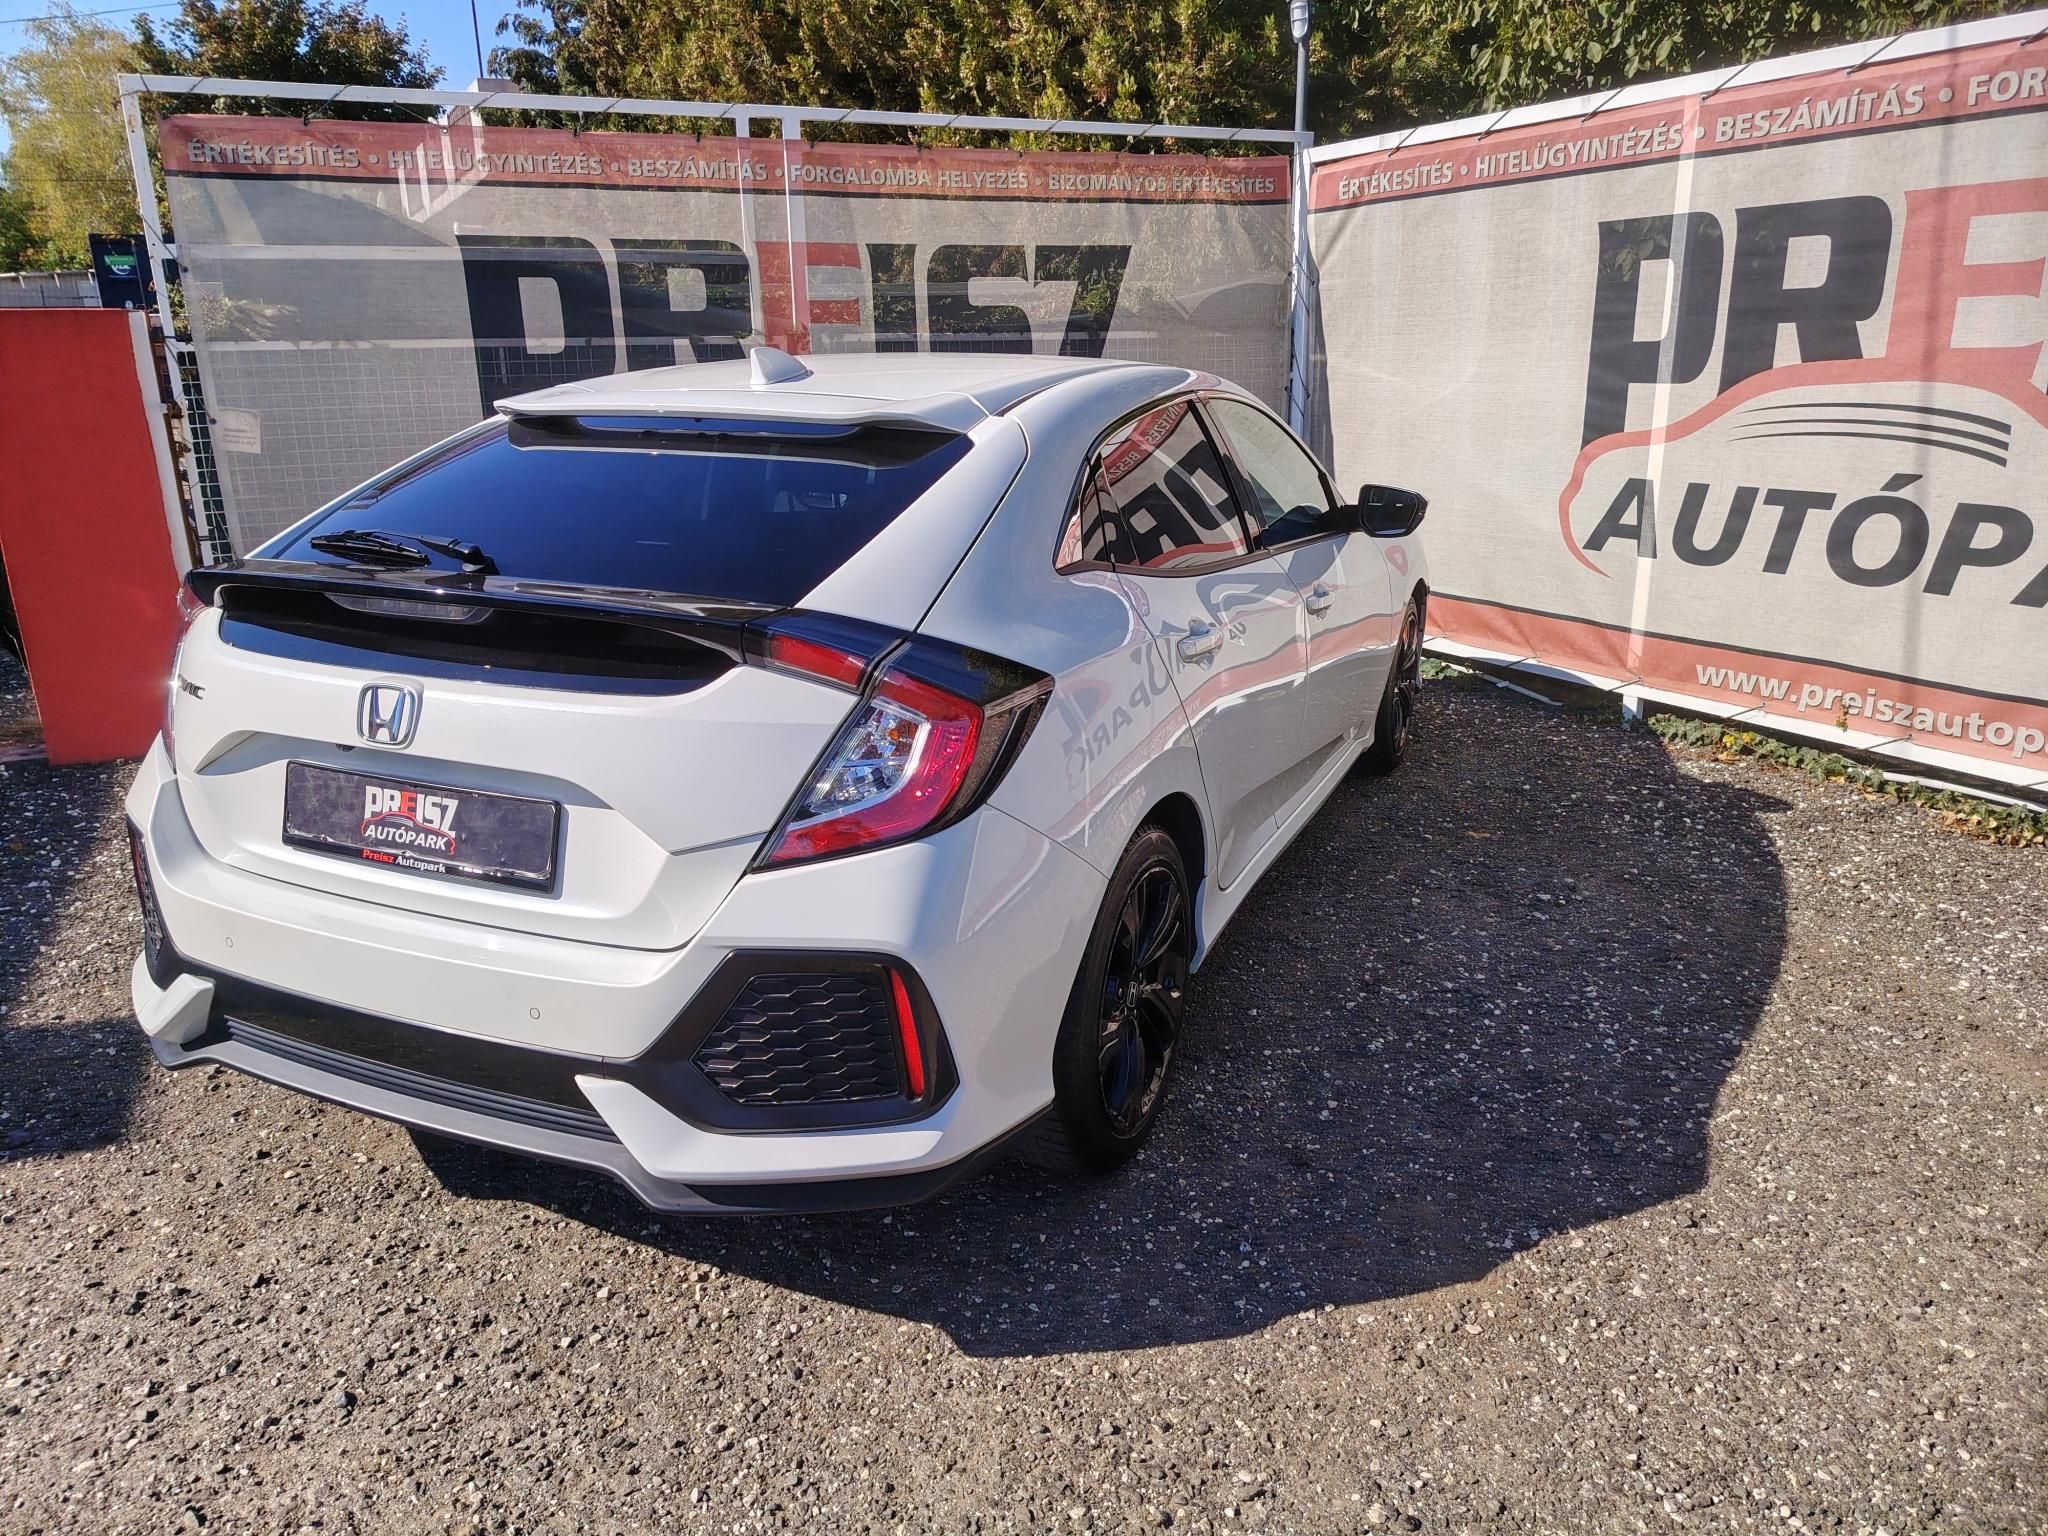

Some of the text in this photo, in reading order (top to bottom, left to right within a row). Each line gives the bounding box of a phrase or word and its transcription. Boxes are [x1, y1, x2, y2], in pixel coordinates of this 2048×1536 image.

[187, 138, 360, 168] ÉRTÉKESÍTÉS
[387, 149, 603, 176] HITELÜGYINTÉZÉS
[627, 155, 768, 181] BESZÁMÍTÁS
[791, 164, 931, 187] FORGALOMBA
[937, 167, 1029, 189] HELYEZÉS
[1049, 172, 1167, 193] BIZOMÁNYOS
[1338, 66, 2048, 200] ÉRTÉKESÍTÉS HITELÜGYINTÉZÉS BESZÁMÍTÁS FOR
[1580, 177, 2048, 450] PRE
[1582, 472, 2048, 608] AUTÓP
[1696, 664, 2048, 759] www.preiszautop
[364, 785, 459, 839] PREISZ
[365, 824, 448, 851] AUTÓPARK
[363, 849, 446, 873] Preisz Autopark
